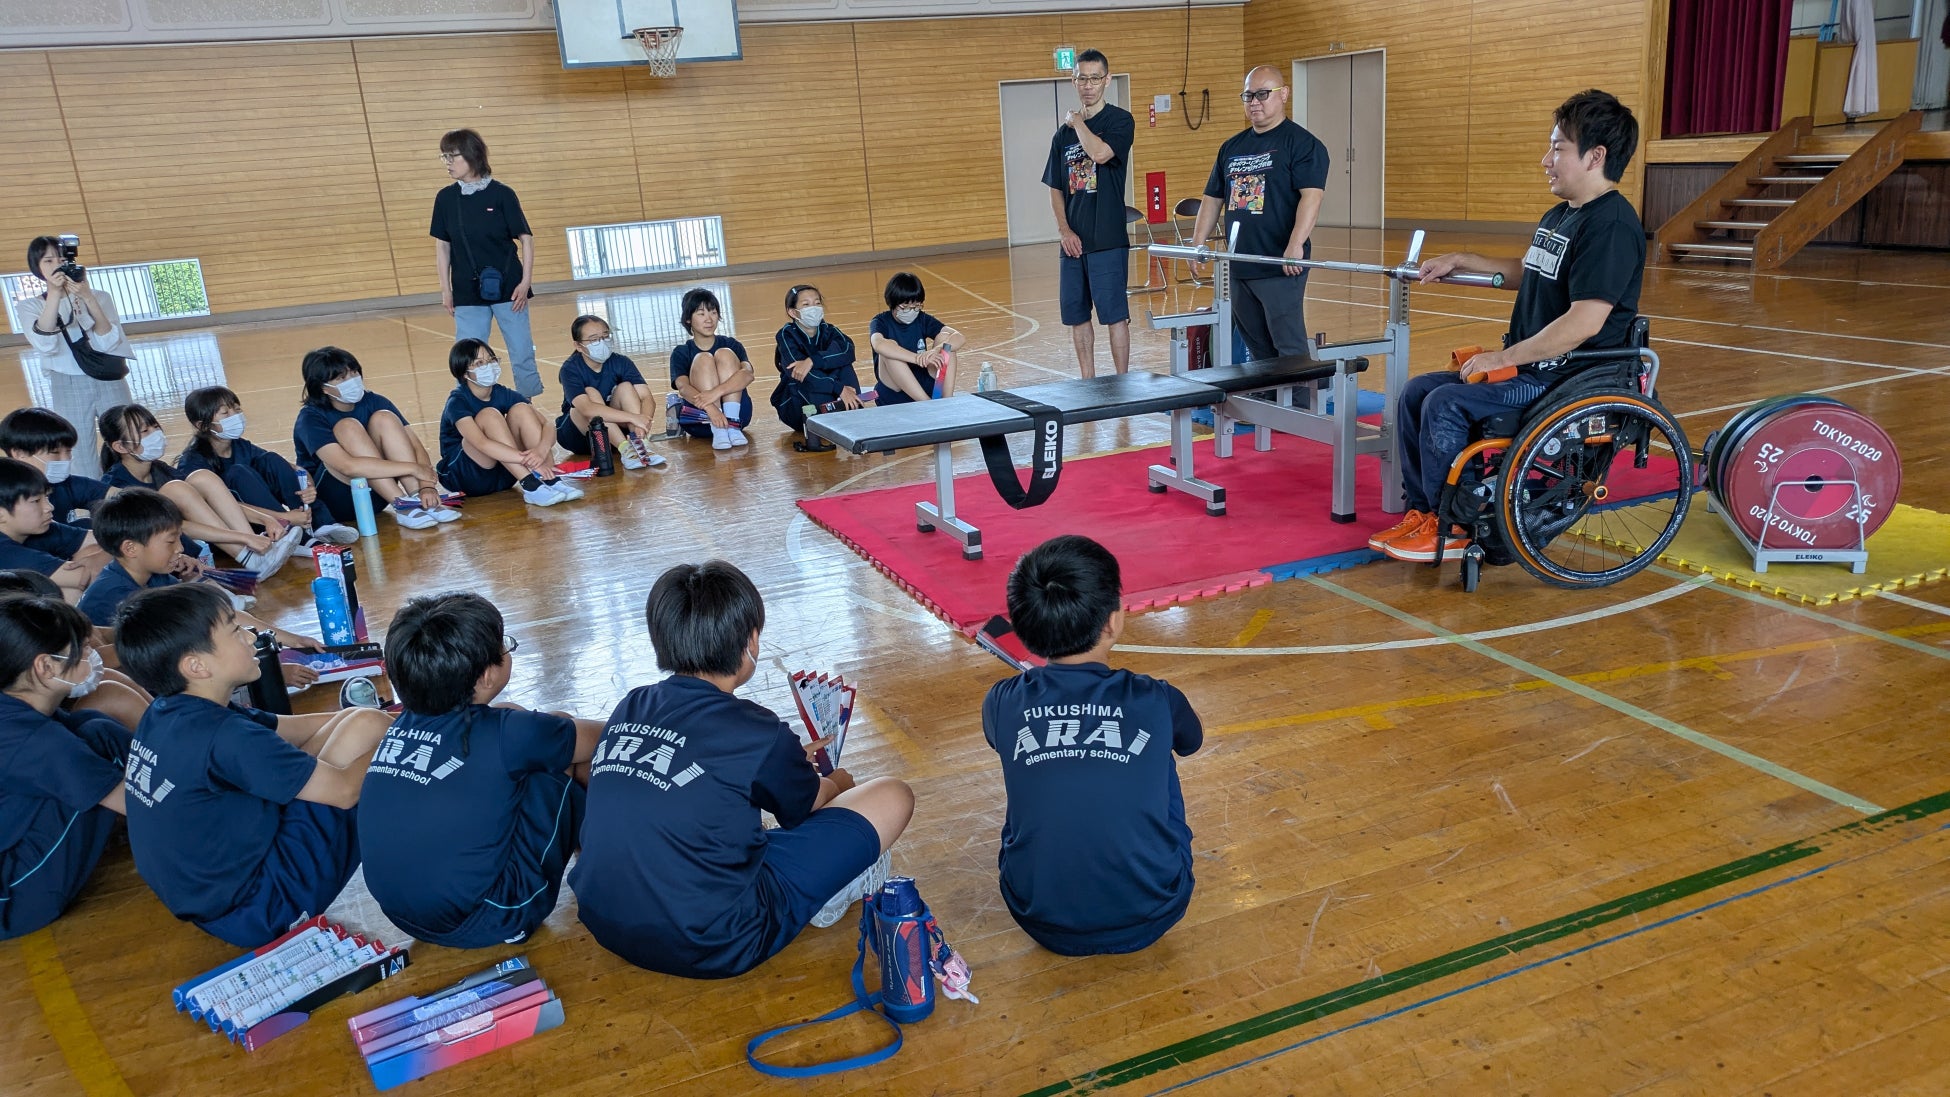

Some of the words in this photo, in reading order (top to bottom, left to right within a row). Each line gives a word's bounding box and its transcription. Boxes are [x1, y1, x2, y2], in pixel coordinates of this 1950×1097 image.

[1042, 420, 1058, 479] ELEIKO
[1758, 443, 1784, 463] 25
[1812, 420, 1852, 446] TOKYO
[1850, 440, 1882, 462] 2020
[1845, 504, 1872, 524] 25
[1778, 520, 1817, 545] TOKYO
[1023, 703, 1124, 722] FUKUSHIMA
[608, 722, 687, 748] FUKUSHIMA
[1013, 719, 1151, 761] ARAI
[591, 735, 705, 788] ARAI
[1025, 748, 1086, 766] elementary
[1089, 749, 1131, 764] school
[125, 753, 176, 803] RAI
[400, 769, 432, 785] school
[636, 769, 671, 791] school
